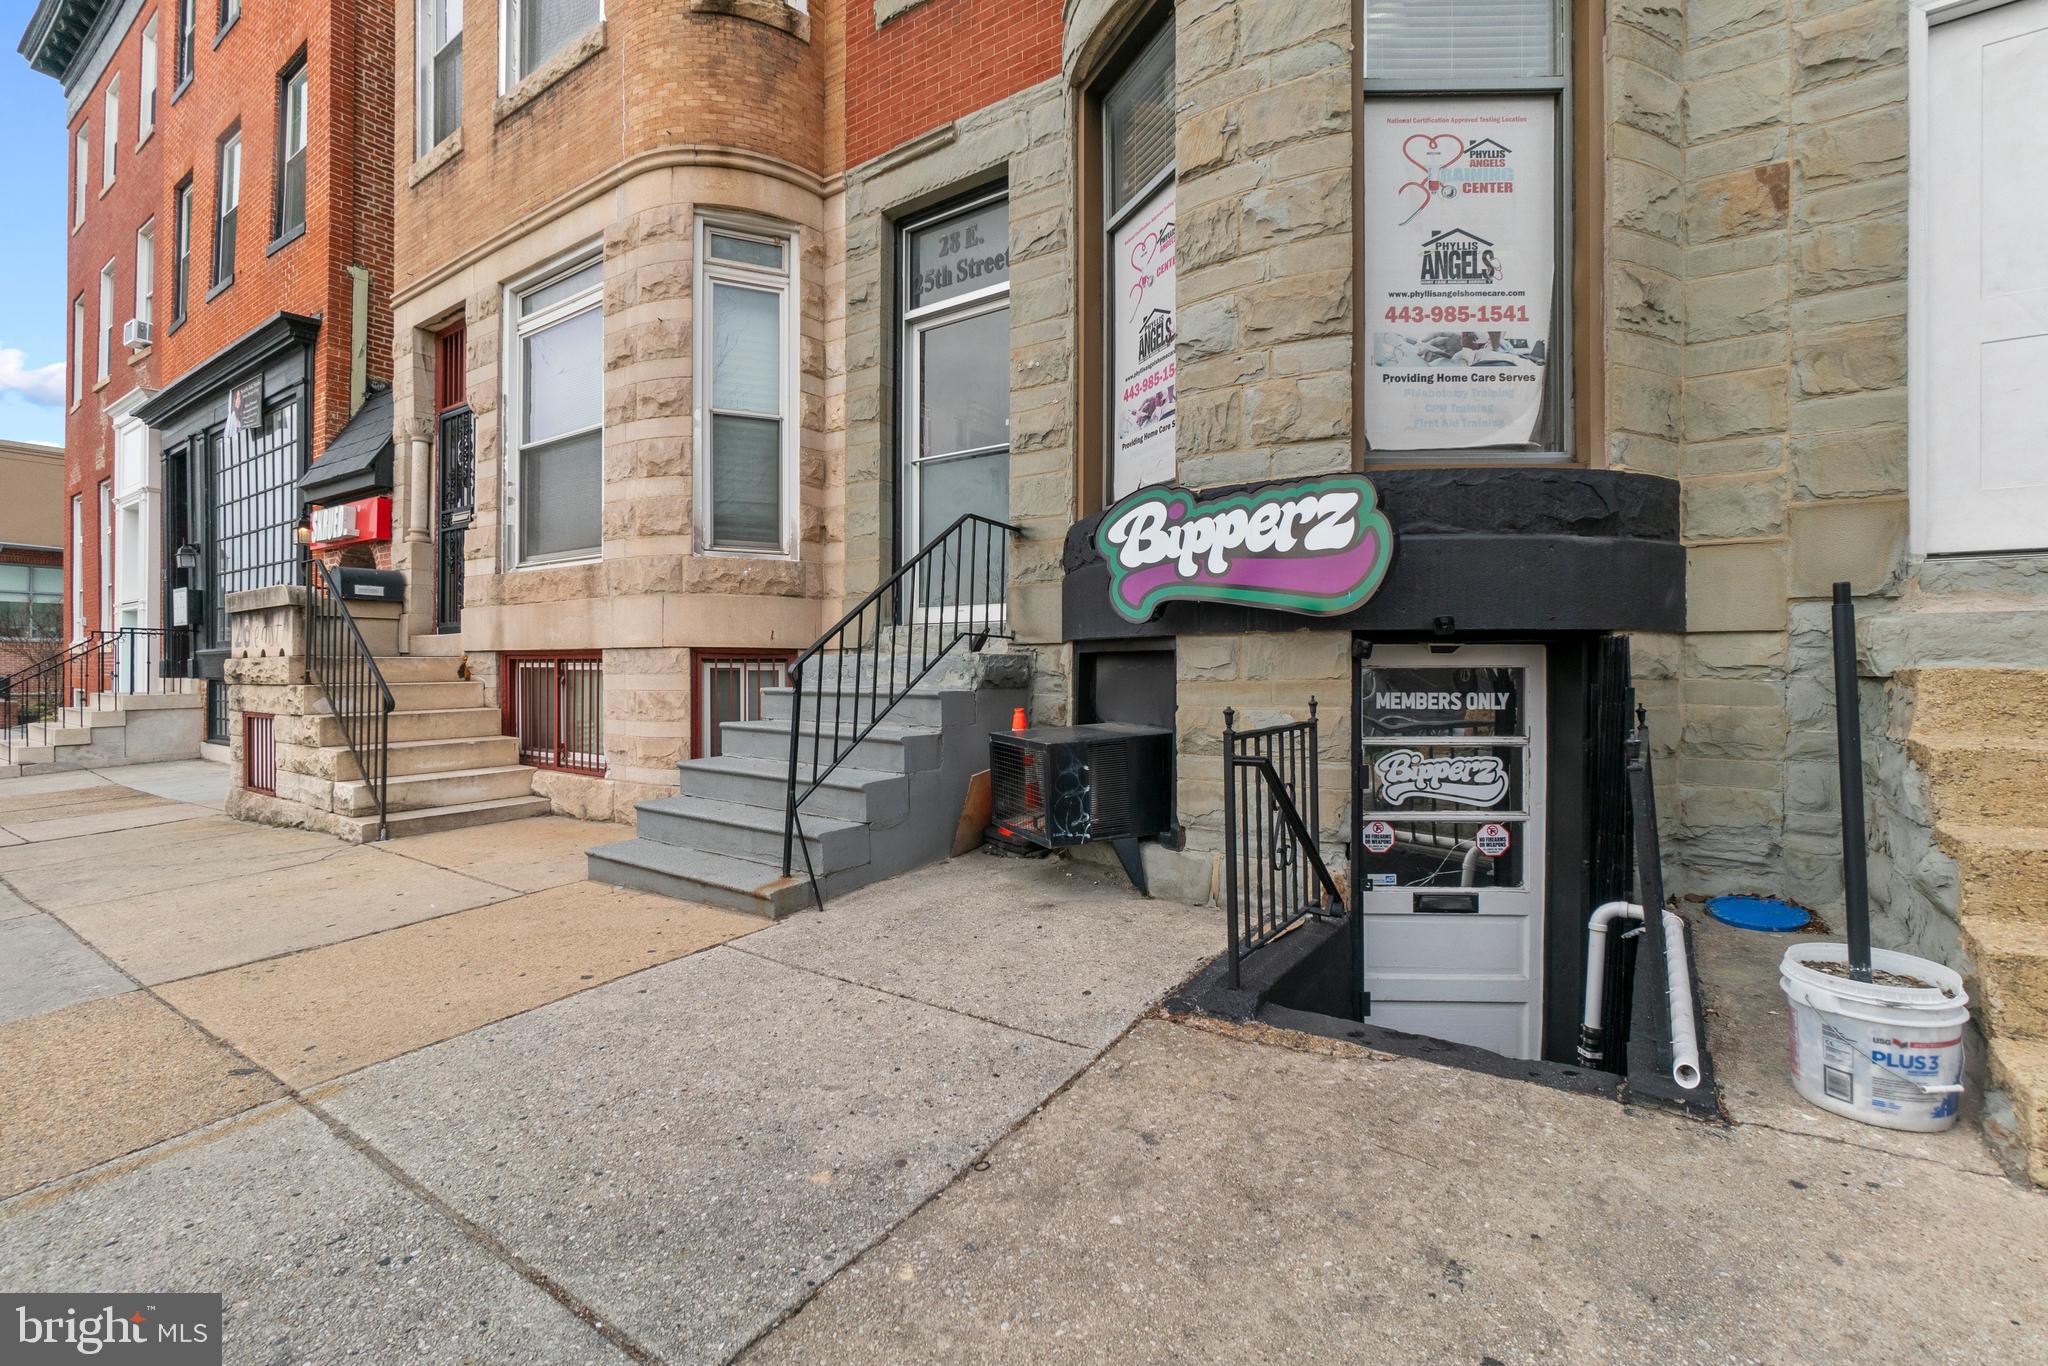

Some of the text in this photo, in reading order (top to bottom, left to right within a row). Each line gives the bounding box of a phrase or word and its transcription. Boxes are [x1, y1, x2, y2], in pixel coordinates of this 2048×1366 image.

[1451, 116, 1478, 124] Approved
[1480, 116, 1500, 124] Testing
[1470, 150, 1505, 159] PHYLLIS
[1470, 159, 1506, 168] ANGELS
[1462, 182, 1513, 194] CENTER
[939, 224, 985, 258] 28 E.
[1435, 241, 1478, 251] PHYLLIS
[1421, 250, 1496, 280] ANGELS
[914, 265, 953, 295] 25th
[1388, 289, 1525, 300] www.phyllisangelshomecare.com
[1384, 305, 1529, 323] 443-985-1541
[1138, 317, 1173, 361] ANGELS
[1123, 362, 1176, 402] 443-985-15
[1382, 372, 1536, 385] Providing Home Care Serves
[1471, 388, 1516, 399] Training
[1451, 403, 1496, 414] Training
[1414, 418, 1505, 429] First Aid Training
[1122, 435, 1143, 451] Providing
[1144, 430, 1158, 440] Home
[1158, 424, 1171, 434] Care
[1108, 492, 1359, 577] Bipperz
[1376, 692, 1510, 710] MEMBERS ONLY
[1378, 752, 1499, 790] Bipperz
[1872, 1036, 1891, 1046] USG
[1872, 1050, 1939, 1071] PLUS 3
